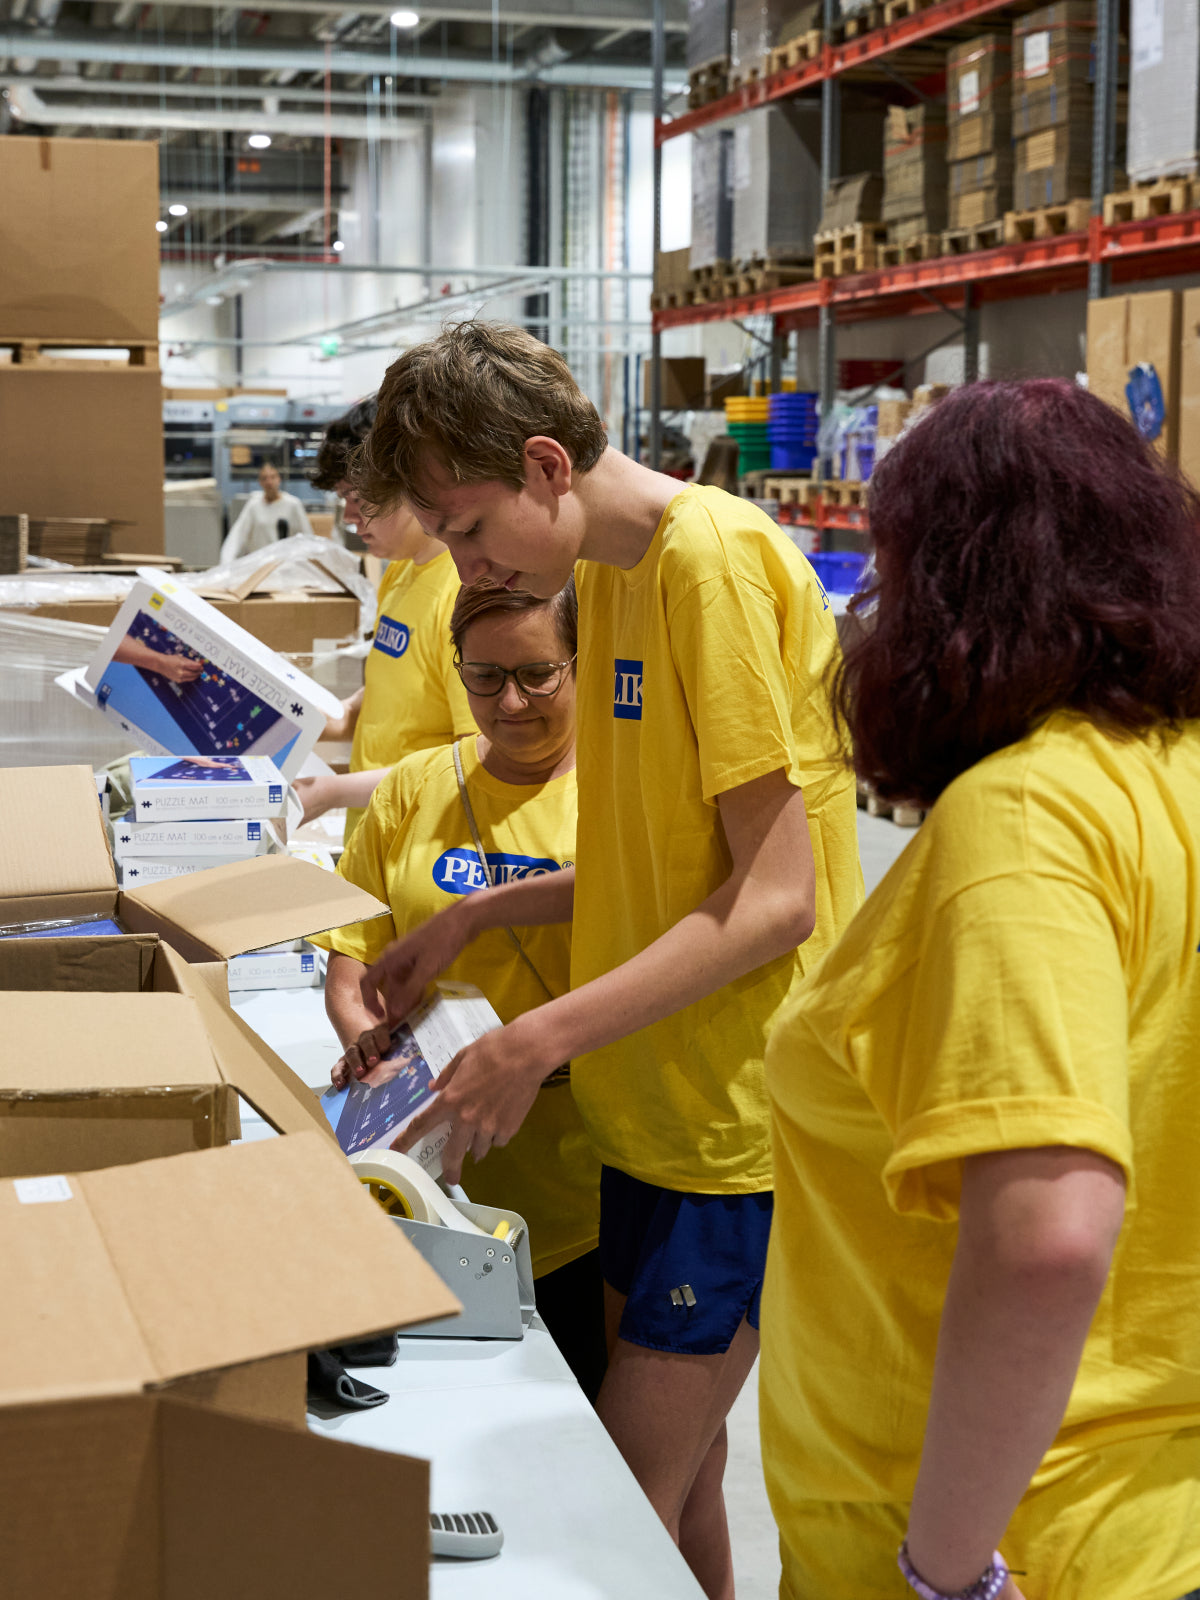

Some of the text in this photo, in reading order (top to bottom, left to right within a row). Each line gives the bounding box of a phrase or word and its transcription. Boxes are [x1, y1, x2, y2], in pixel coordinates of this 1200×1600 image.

[222, 655, 250, 679] MAT
[249, 674, 288, 709] PUZZLE
[155, 797, 186, 806] PUZZLE
[188, 796, 209, 805] MAT
[134, 832, 165, 841] PUZZLE
[166, 832, 187, 841] MAT
[142, 865, 174, 875] PUZZLE
[416, 1145, 434, 1162] 100
[434, 1136, 446, 1148] cm
